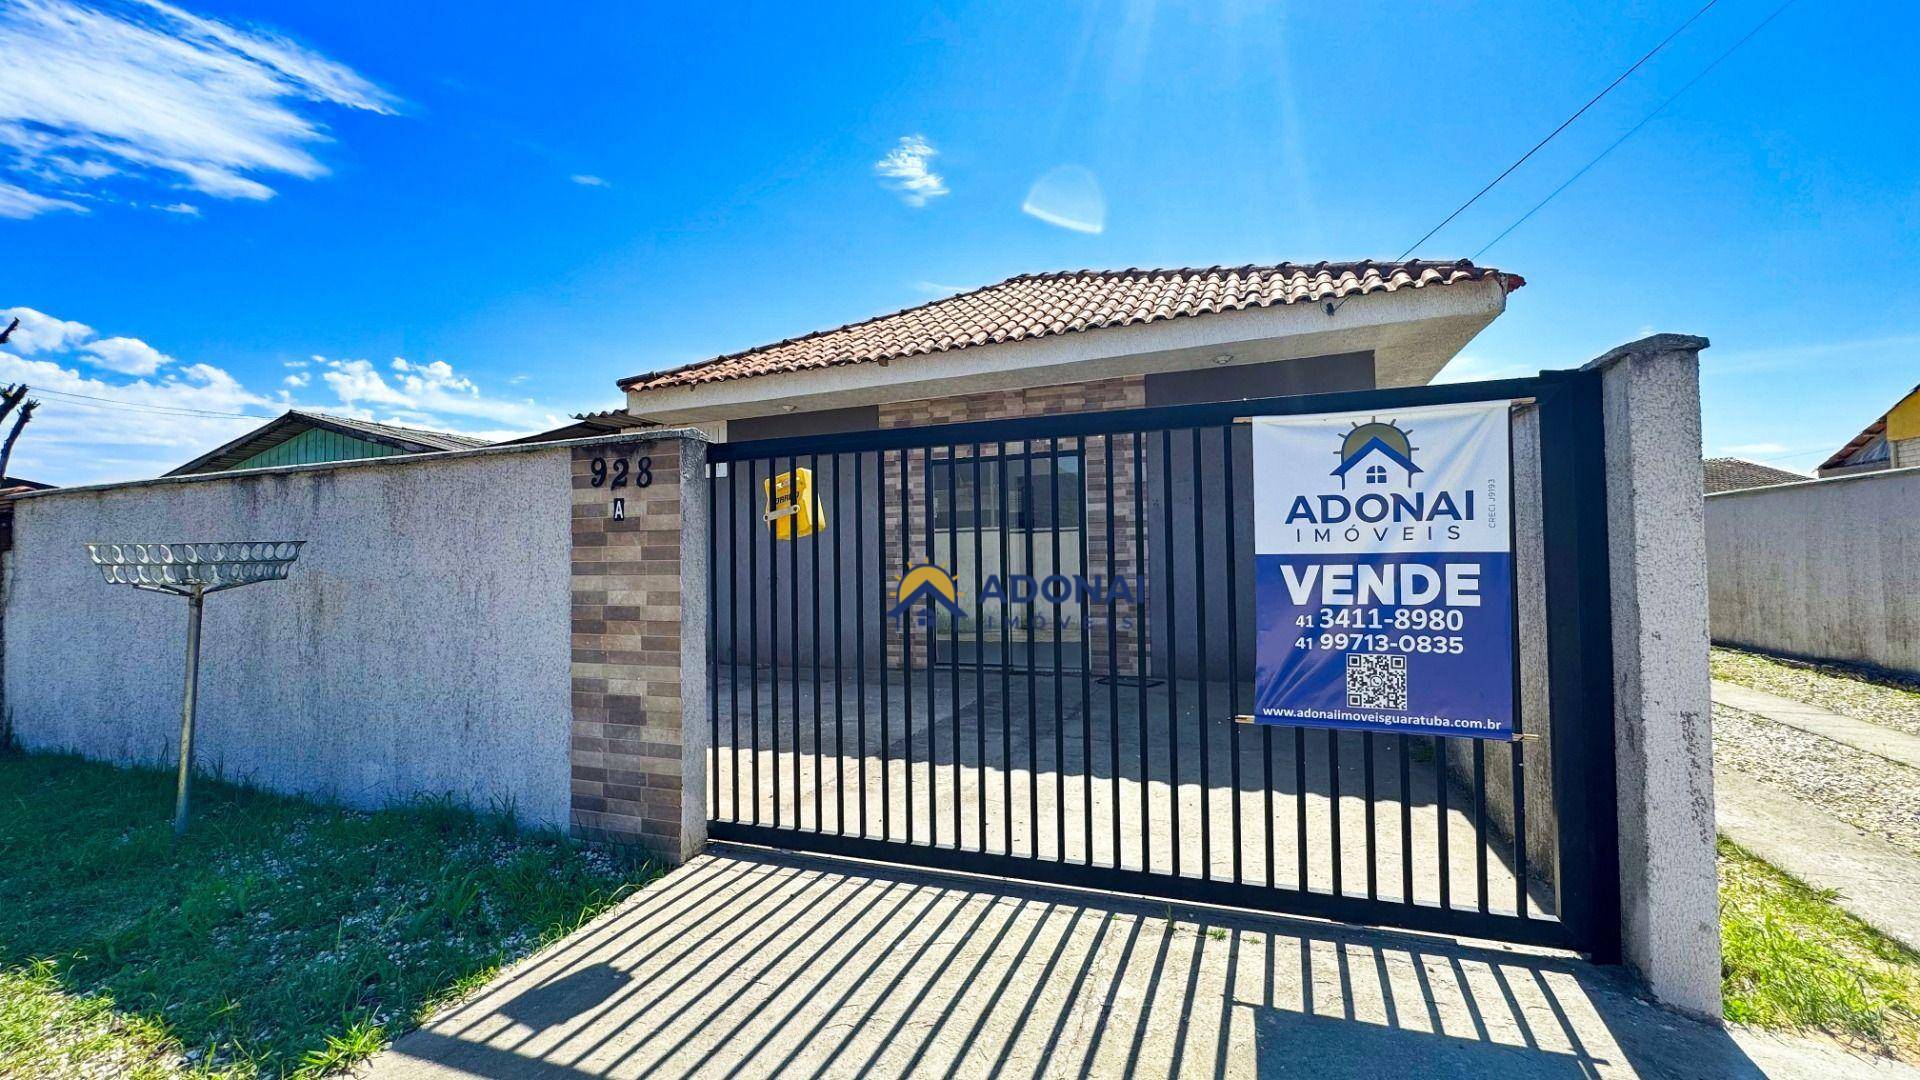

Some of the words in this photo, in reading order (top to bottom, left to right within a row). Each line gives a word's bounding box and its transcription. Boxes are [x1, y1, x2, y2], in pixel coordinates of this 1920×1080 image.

[591, 456, 652, 491] 928
[614, 502, 624, 519] A
[1284, 490, 1474, 524] ADONAI
[1488, 504, 1496, 528] CRECI
[1296, 524, 1460, 542] IMÓVEIS
[1280, 563, 1480, 607] VENDE
[1296, 615, 1313, 628] 41
[1320, 608, 1463, 631] 3411-8980
[1295, 637, 1312, 649] 41
[1320, 634, 1464, 654] 99713-0835
[1263, 707, 1502, 731] www.adonaiimoveisguaratuba.com.br
